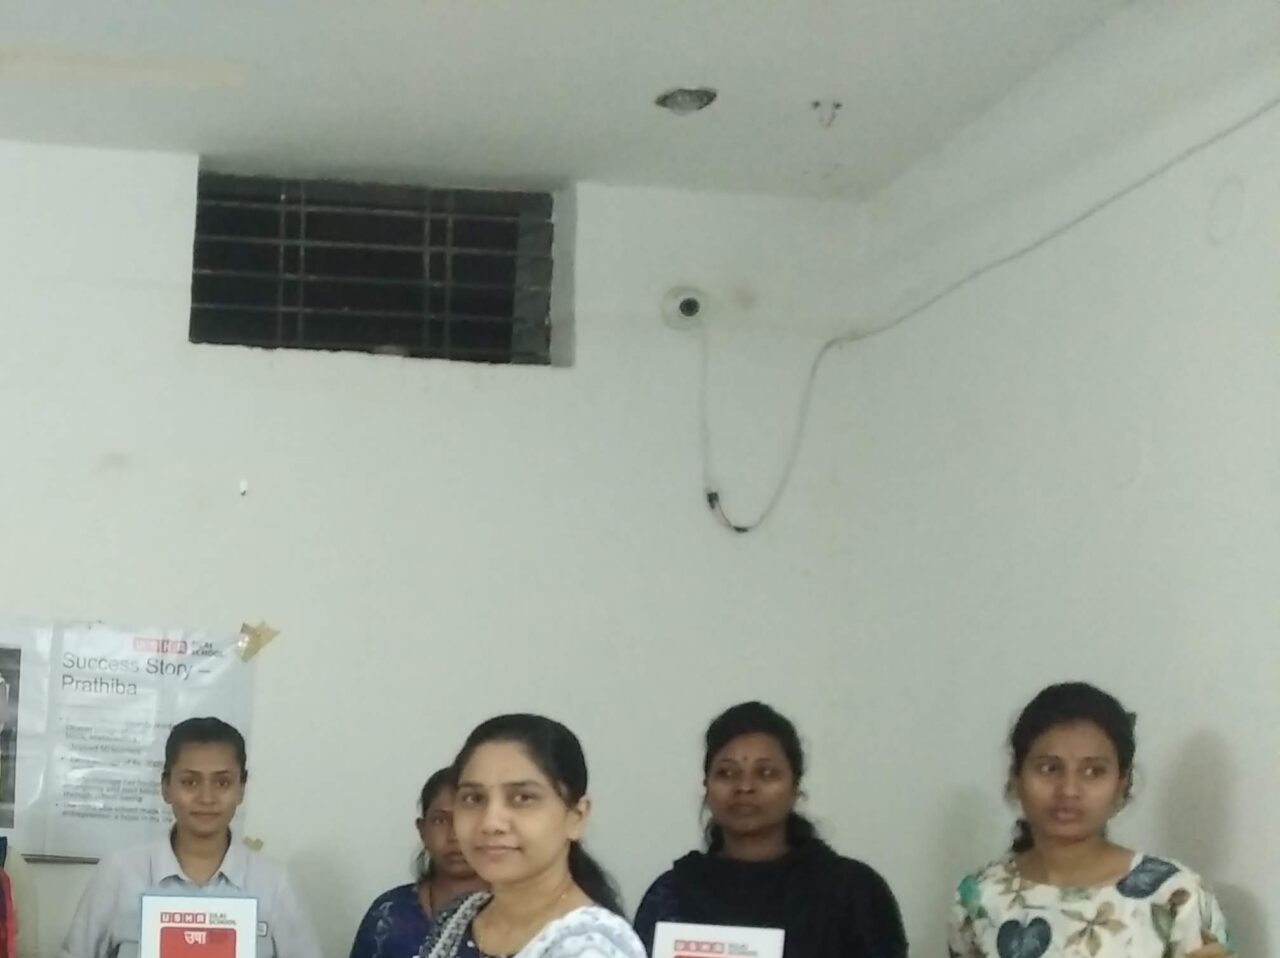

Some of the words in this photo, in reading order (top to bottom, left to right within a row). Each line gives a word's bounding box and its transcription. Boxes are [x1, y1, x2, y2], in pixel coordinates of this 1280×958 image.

[62, 652, 140, 674] Success
[145, 658, 193, 681] Story
[62, 674, 138, 696] Prathiba
